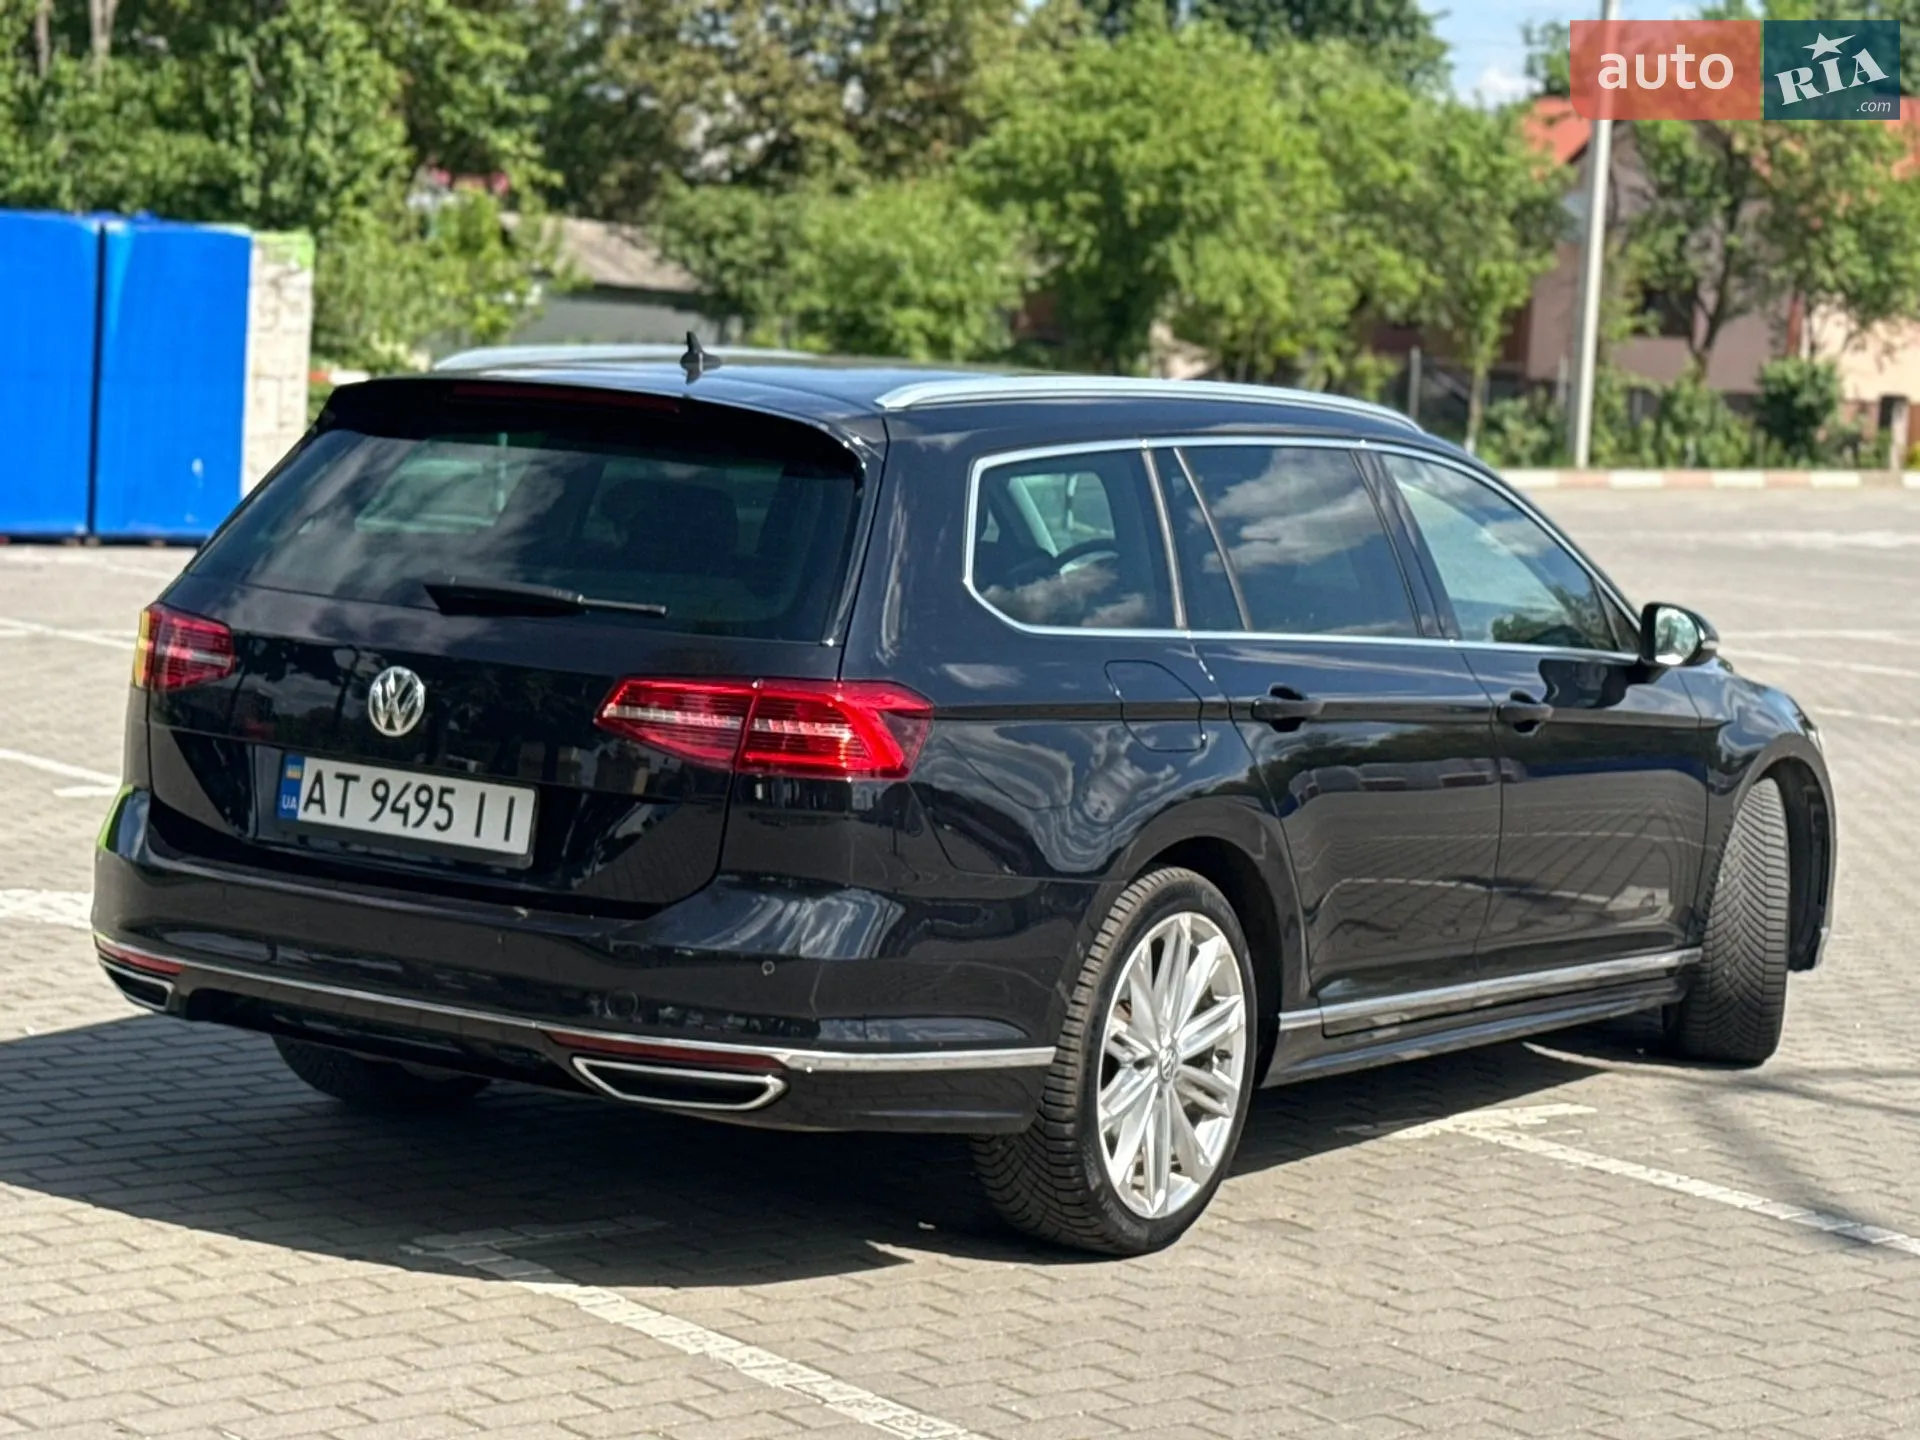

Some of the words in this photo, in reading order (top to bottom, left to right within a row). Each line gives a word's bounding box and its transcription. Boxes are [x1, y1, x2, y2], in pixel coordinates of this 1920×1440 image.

[281, 793, 298, 811] UA
[303, 769, 361, 819] AT
[368, 777, 456, 832] 9495
